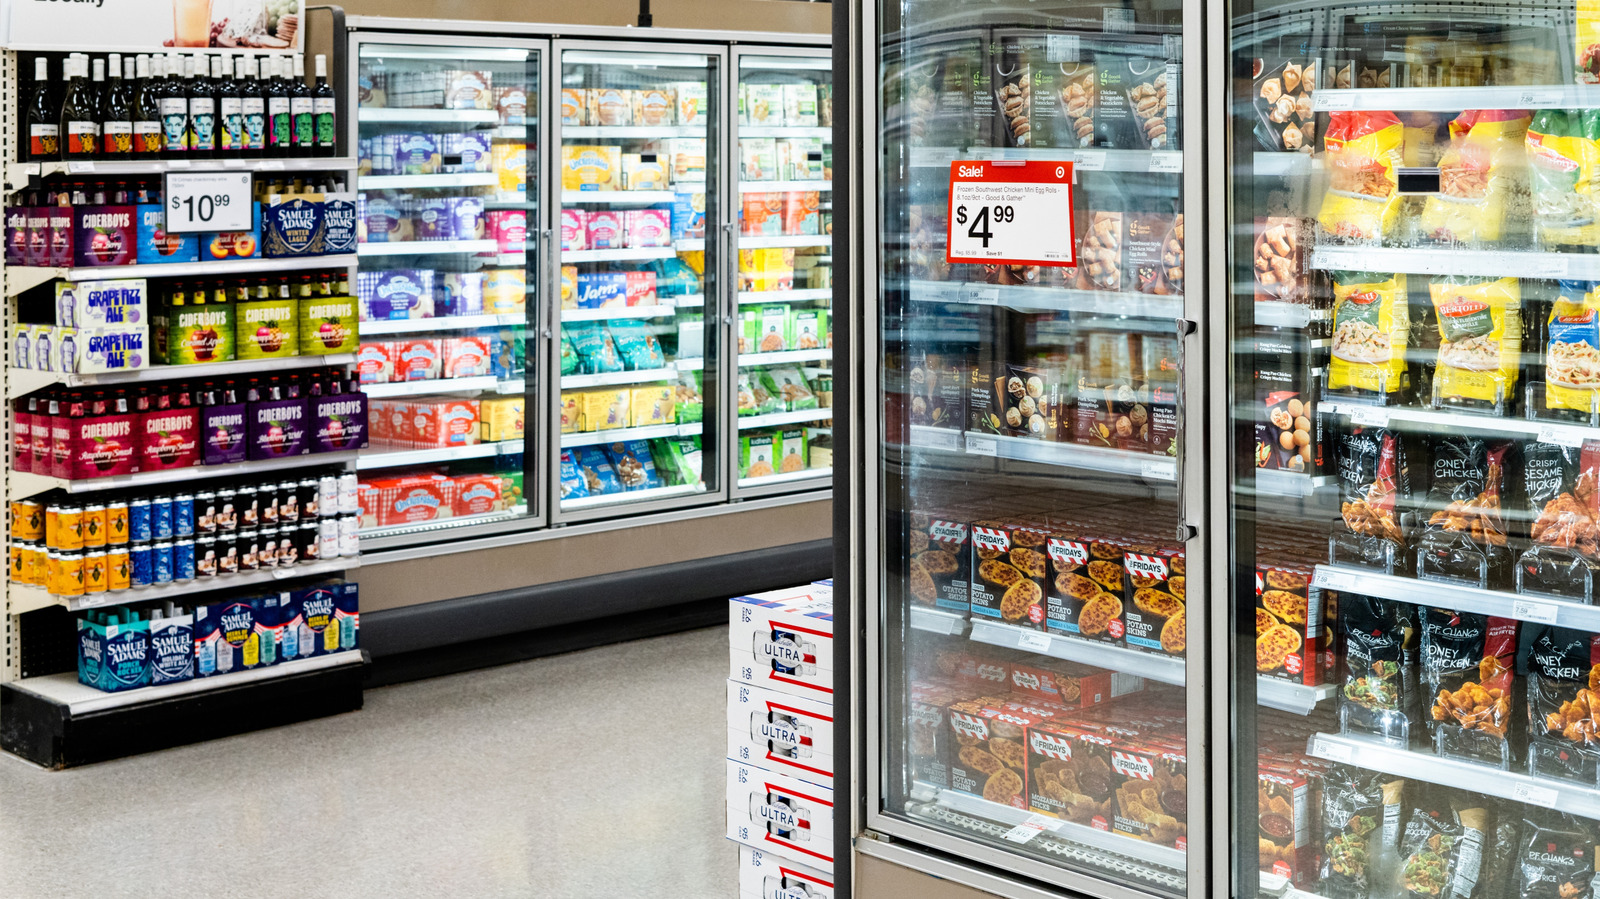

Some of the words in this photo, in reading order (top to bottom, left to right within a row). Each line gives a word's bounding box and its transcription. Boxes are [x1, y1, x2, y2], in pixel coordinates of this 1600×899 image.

[958, 165, 984, 178] Sale!
[82, 213, 130, 228] CIDERBOYS
[278, 208, 316, 221] SAMUEL
[324, 208, 356, 220] SAMUEL
[282, 218, 314, 231] ADAMS
[325, 218, 352, 229] ADAMS
[578, 282, 619, 302] Jams
[626, 282, 650, 297] ams
[88, 289, 120, 307] GRAPE
[121, 288, 141, 306] FIZZ
[106, 306, 124, 323] ALE
[245, 307, 291, 324] CIDERBOYS
[309, 304, 352, 319] CIDERBOYS
[1439, 304, 1484, 315] BERTOLLI
[178, 312, 226, 328] CIDERBOYS
[88, 334, 120, 352] GRAPE
[122, 333, 142, 350] FIZZ
[106, 352, 125, 368] ALE
[258, 406, 302, 423] CIDERBOYS
[318, 400, 362, 418] CIDERBOYS
[146, 416, 192, 433] CIDERBOYS
[208, 414, 242, 428] CIDERBOYS
[82, 420, 130, 439] CIDERBOYS
[784, 430, 802, 438] kidfresh
[750, 437, 772, 445] kidfresh
[79, 450, 114, 460] Raspberry
[144, 444, 176, 454] Raspberry
[1435, 458, 1467, 469] ONEY
[1529, 459, 1558, 467] CRISPY
[1435, 469, 1483, 479] CHICKEN
[1525, 467, 1563, 479] SESAME
[979, 534, 1004, 546] FRIDAYS
[1055, 546, 1082, 558] FRIDAYS
[1133, 561, 1162, 573] FRIDAYS
[972, 590, 994, 600] POTATO
[303, 598, 334, 611] SAMUEL
[972, 598, 989, 606] SKINS
[306, 606, 332, 618] ADAMS
[744, 608, 752, 623] 2.6
[1048, 604, 1072, 615] POTATO
[1048, 611, 1066, 621] SKINS
[220, 612, 254, 626] SAMUEL
[1126, 620, 1153, 631] POTATO
[224, 620, 250, 632] ADAMS
[1126, 627, 1147, 637] SKINS
[108, 638, 148, 656] SAMUEL
[152, 633, 193, 650] SAMUEL
[112, 650, 146, 665] ADAMS
[156, 644, 190, 658] ADAMS
[764, 644, 800, 662] ULTRA
[118, 660, 140, 669] PORCH
[161, 654, 185, 662] HOLIDAY
[1426, 656, 1471, 669] CHICKEN
[746, 667, 752, 680] 95
[742, 688, 750, 703] 2.6
[958, 720, 983, 733] FRIDAYS
[762, 724, 797, 744] ULTRA
[742, 746, 750, 760] 95
[1038, 740, 1066, 754] FRIDAYS
[1120, 759, 1148, 774] FRIDAYS
[952, 776, 977, 786] POTATO
[952, 782, 972, 792] SKINS
[1031, 793, 1066, 809] MOZZARELLA
[1031, 800, 1050, 811] STICKS
[760, 806, 795, 826] ULTRA
[1114, 815, 1149, 830] MOZZARELLA
[742, 827, 748, 840] 95
[1114, 822, 1133, 833] STICKS
[1529, 851, 1541, 860] P.F.
